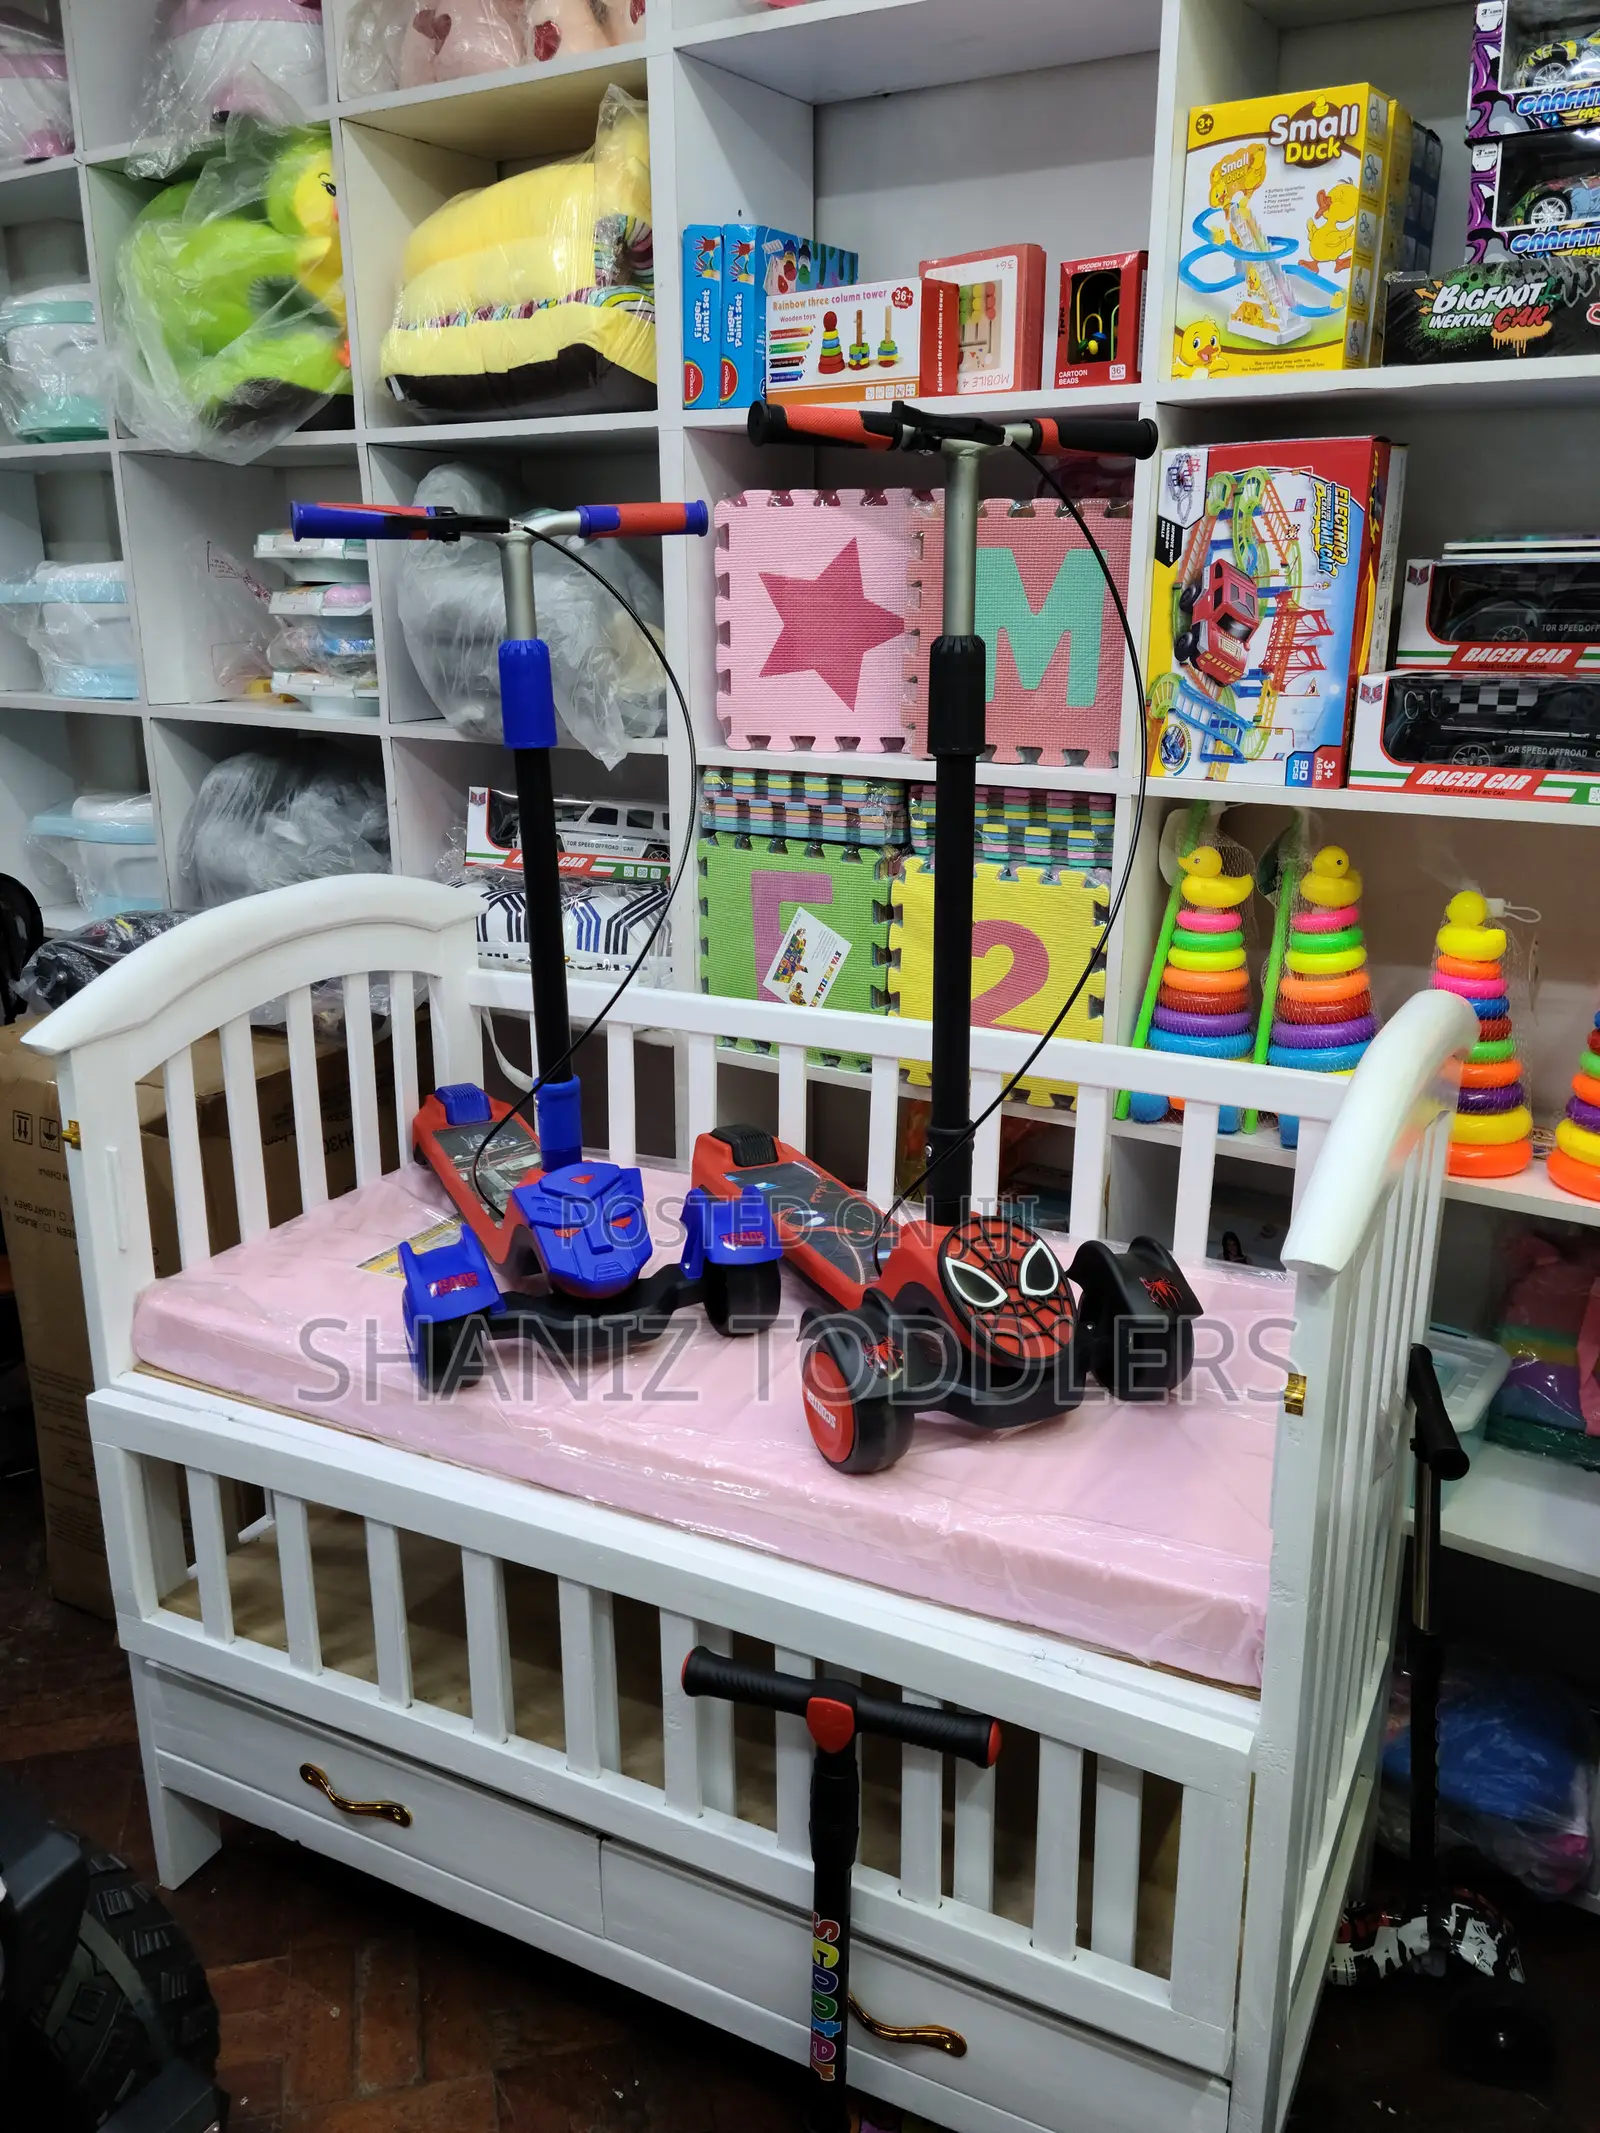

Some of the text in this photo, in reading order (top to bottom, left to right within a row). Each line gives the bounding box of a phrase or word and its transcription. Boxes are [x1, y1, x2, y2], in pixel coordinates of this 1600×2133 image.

[1197, 118, 1213, 129] 3+
[1270, 104, 1360, 145] Small
[1285, 137, 1341, 163] Duck
[1221, 152, 1249, 176] Small
[772, 290, 887, 311] Rainbow three column tower
[894, 289, 913, 301] 36+
[1432, 281, 1548, 314] BIGFOOT
[694, 300, 702, 338] Finger
[702, 289, 711, 343] Paint set
[727, 304, 735, 342] Finger
[735, 293, 743, 348] Paint set
[1428, 305, 1550, 332] INERTIAL CAR
[972, 373, 1010, 389] MOBILE
[1058, 369, 1088, 378] CARTOON
[1058, 377, 1079, 385] BEADS
[1111, 366, 1124, 375] 36+
[1333, 487, 1349, 560] ELECTRIC
[1319, 519, 1334, 572] RAIL CAR
[974, 547, 1108, 708] M
[1461, 647, 1572, 664] RACER CAR
[1521, 746, 1547, 756] SPEED
[1548, 748, 1588, 758] OFFROAD
[1315, 757, 1323, 781] AGES
[1323, 760, 1336, 778] 3+
[1416, 770, 1532, 790] RACER CAR
[558, 856, 589, 868] CAR
[971, 919, 1050, 1036] 2
